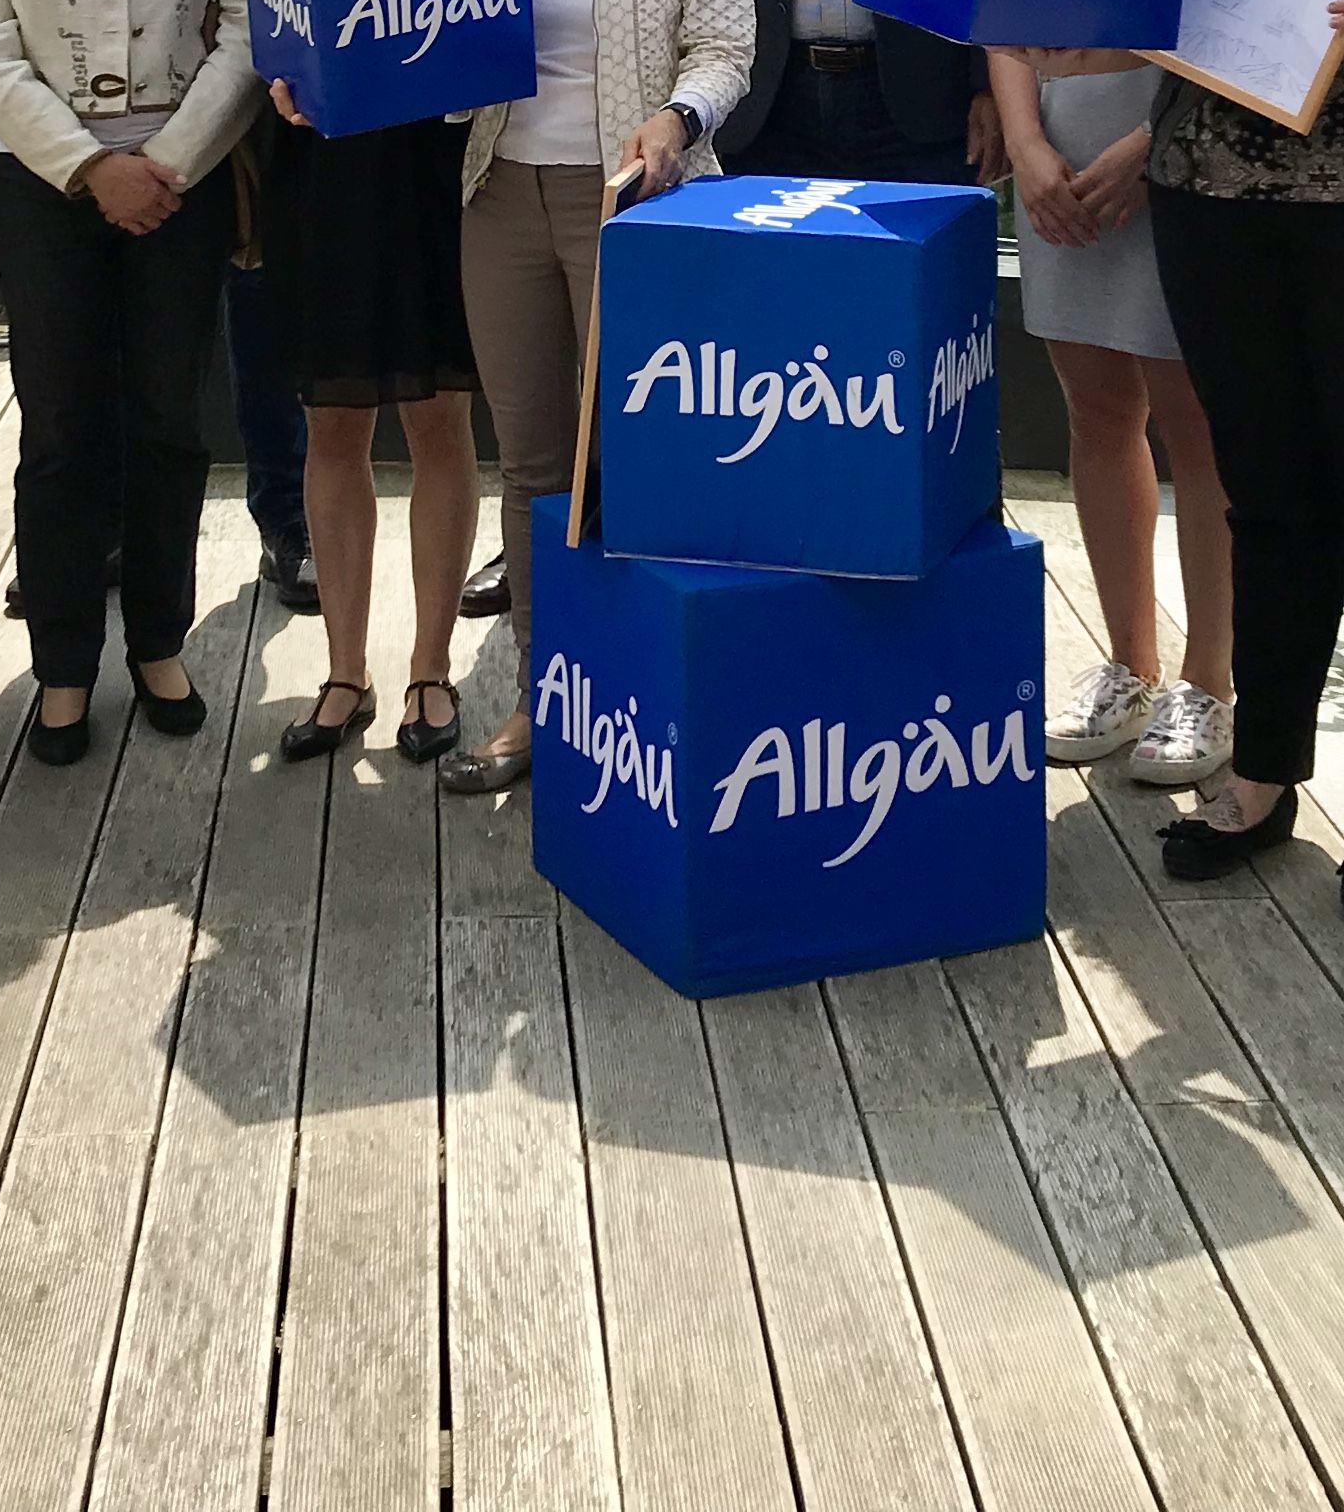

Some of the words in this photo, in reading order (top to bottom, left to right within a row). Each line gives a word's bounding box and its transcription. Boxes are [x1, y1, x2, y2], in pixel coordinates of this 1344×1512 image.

[623, 341, 905, 464] Allgäu
[926, 313, 995, 454] Allgäu
[536, 652, 678, 831] Allgäu
[709, 694, 1036, 869] Allgäu
